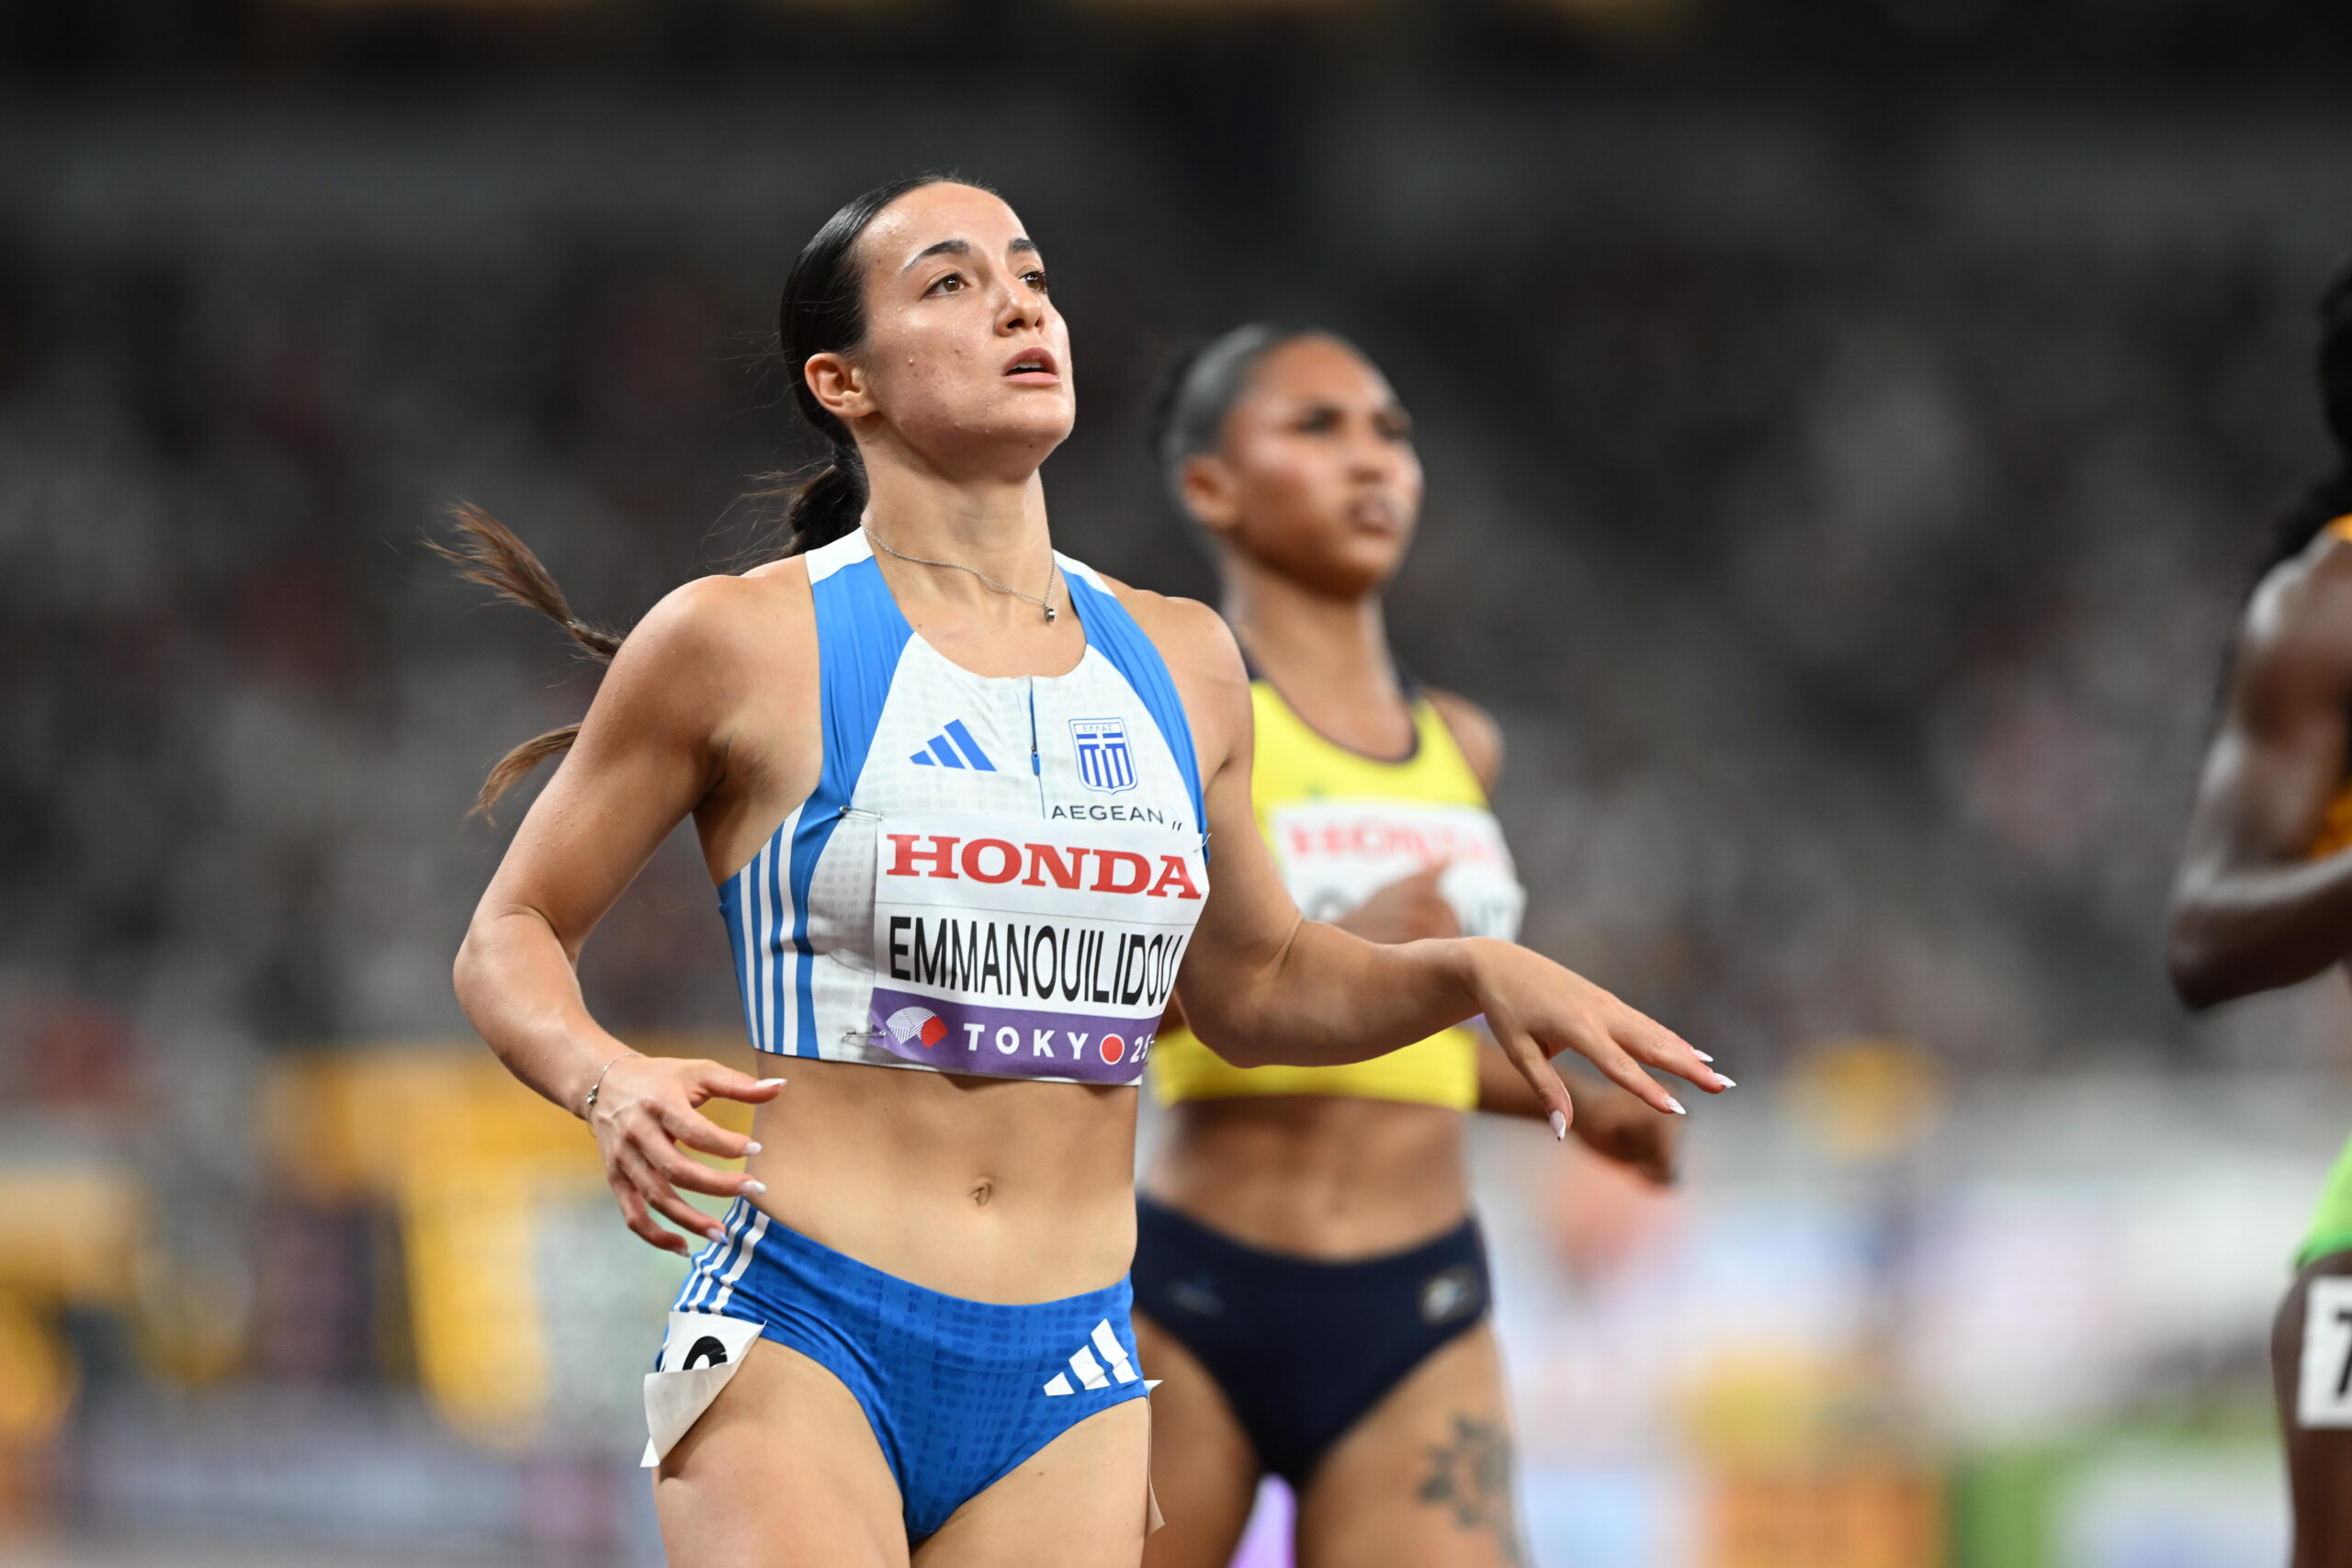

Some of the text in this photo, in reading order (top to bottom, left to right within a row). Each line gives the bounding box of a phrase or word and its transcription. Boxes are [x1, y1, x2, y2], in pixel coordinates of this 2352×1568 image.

[1051, 805, 1164, 825] AEGEAN
[886, 833, 1203, 900] HONDA
[889, 915, 1183, 1008] EMMANOUILIDOU
